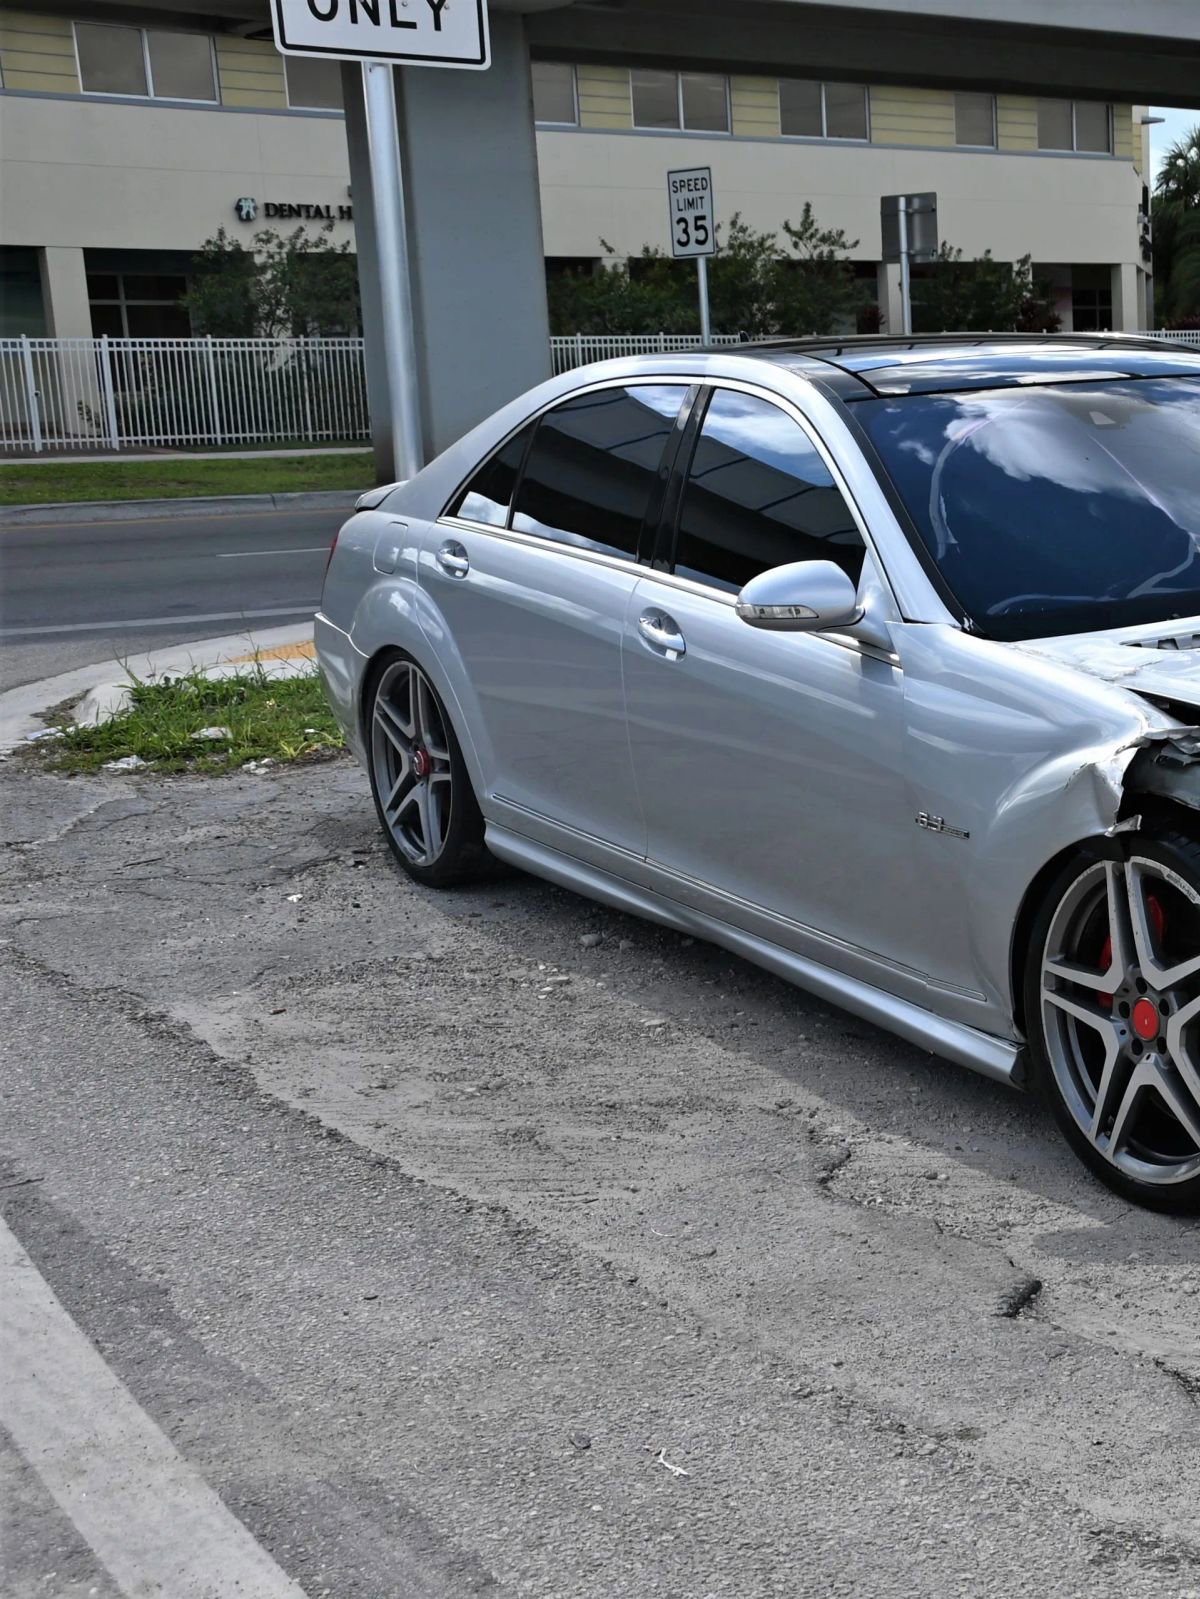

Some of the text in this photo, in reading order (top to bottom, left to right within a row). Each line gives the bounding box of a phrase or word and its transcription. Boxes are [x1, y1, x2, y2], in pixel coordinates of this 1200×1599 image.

[671, 177, 708, 194] SPEED
[263, 202, 336, 220] DENTAL
[676, 195, 705, 212] LIMIT
[676, 215, 709, 247] 35
